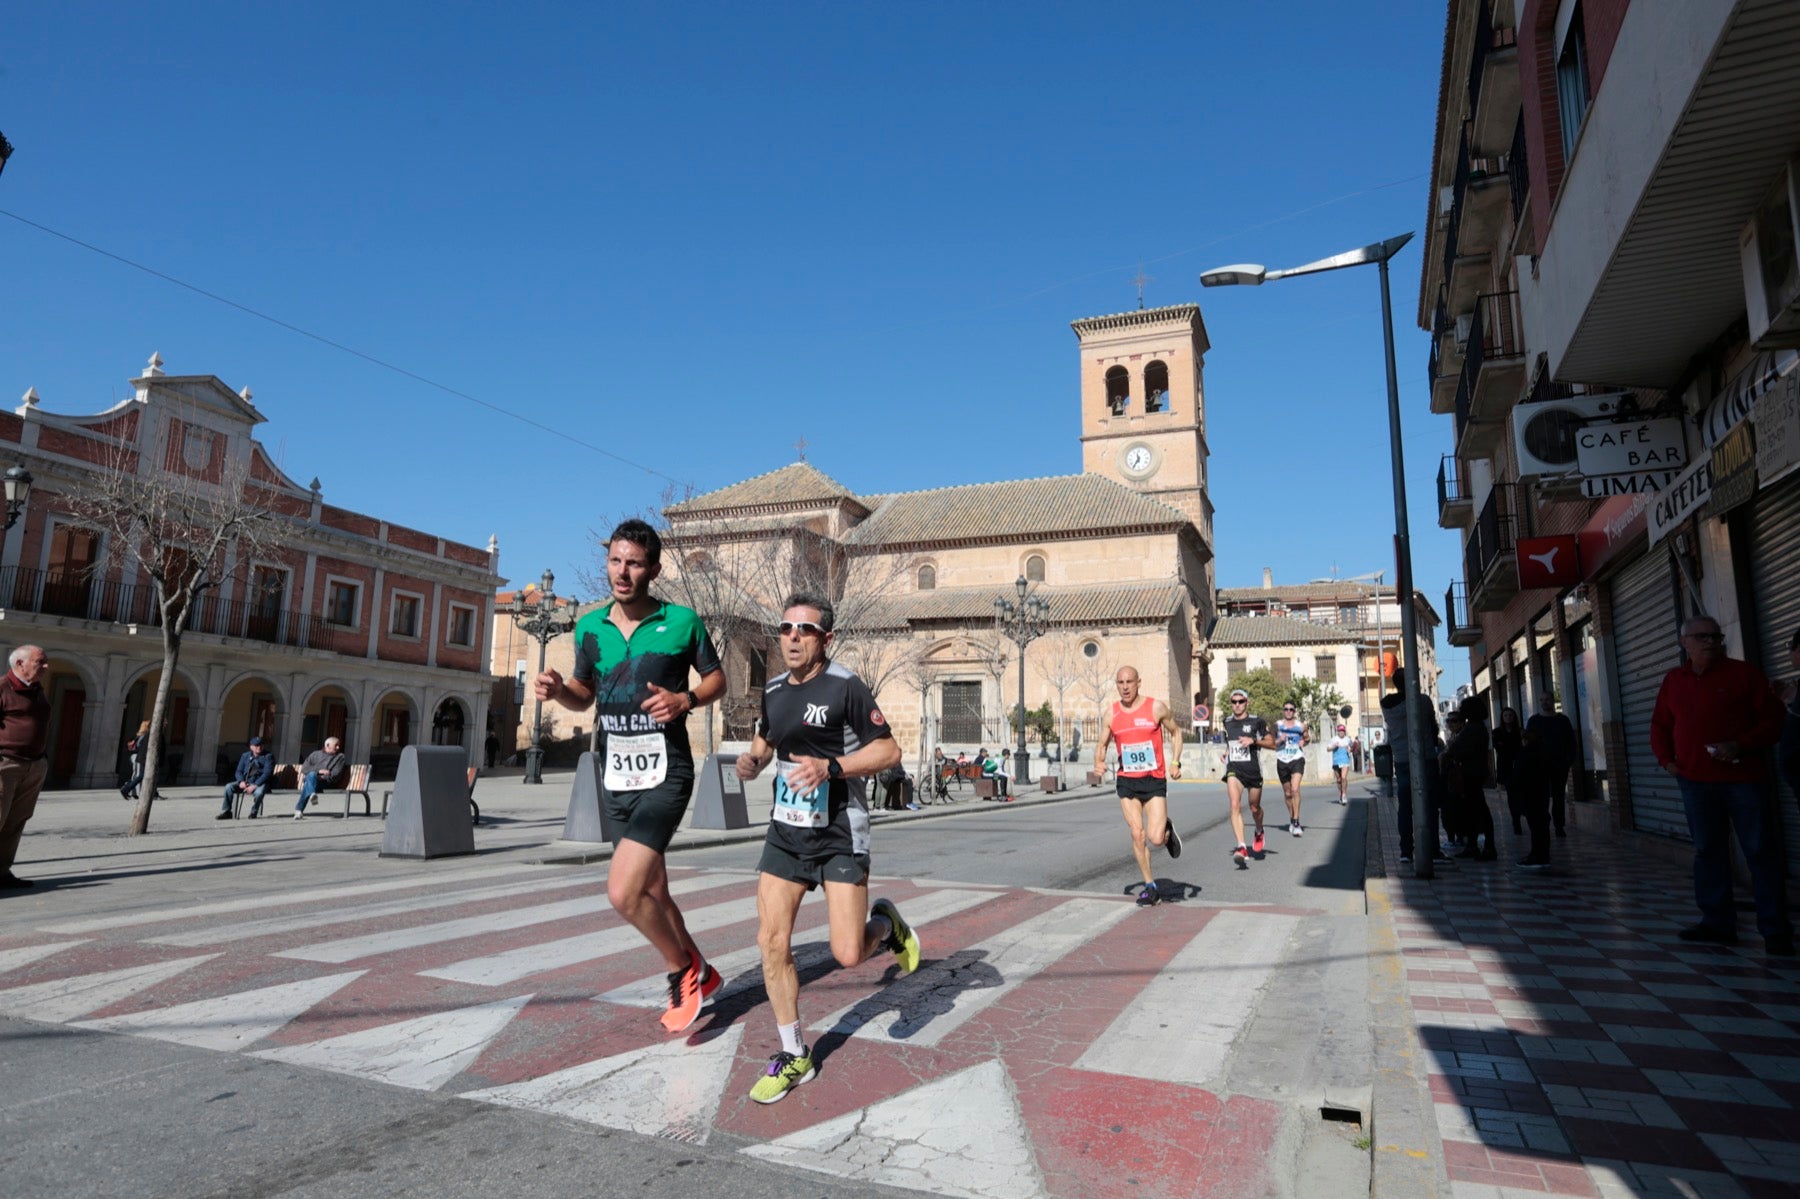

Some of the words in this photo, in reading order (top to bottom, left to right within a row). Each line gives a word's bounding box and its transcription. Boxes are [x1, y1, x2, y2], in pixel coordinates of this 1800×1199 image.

[1580, 425, 1651, 449] CAFÉ
[1628, 446, 1680, 466] BAR
[1586, 474, 1661, 497] LIMA
[612, 752, 661, 772] 3107
[1130, 751, 1146, 763] 98
